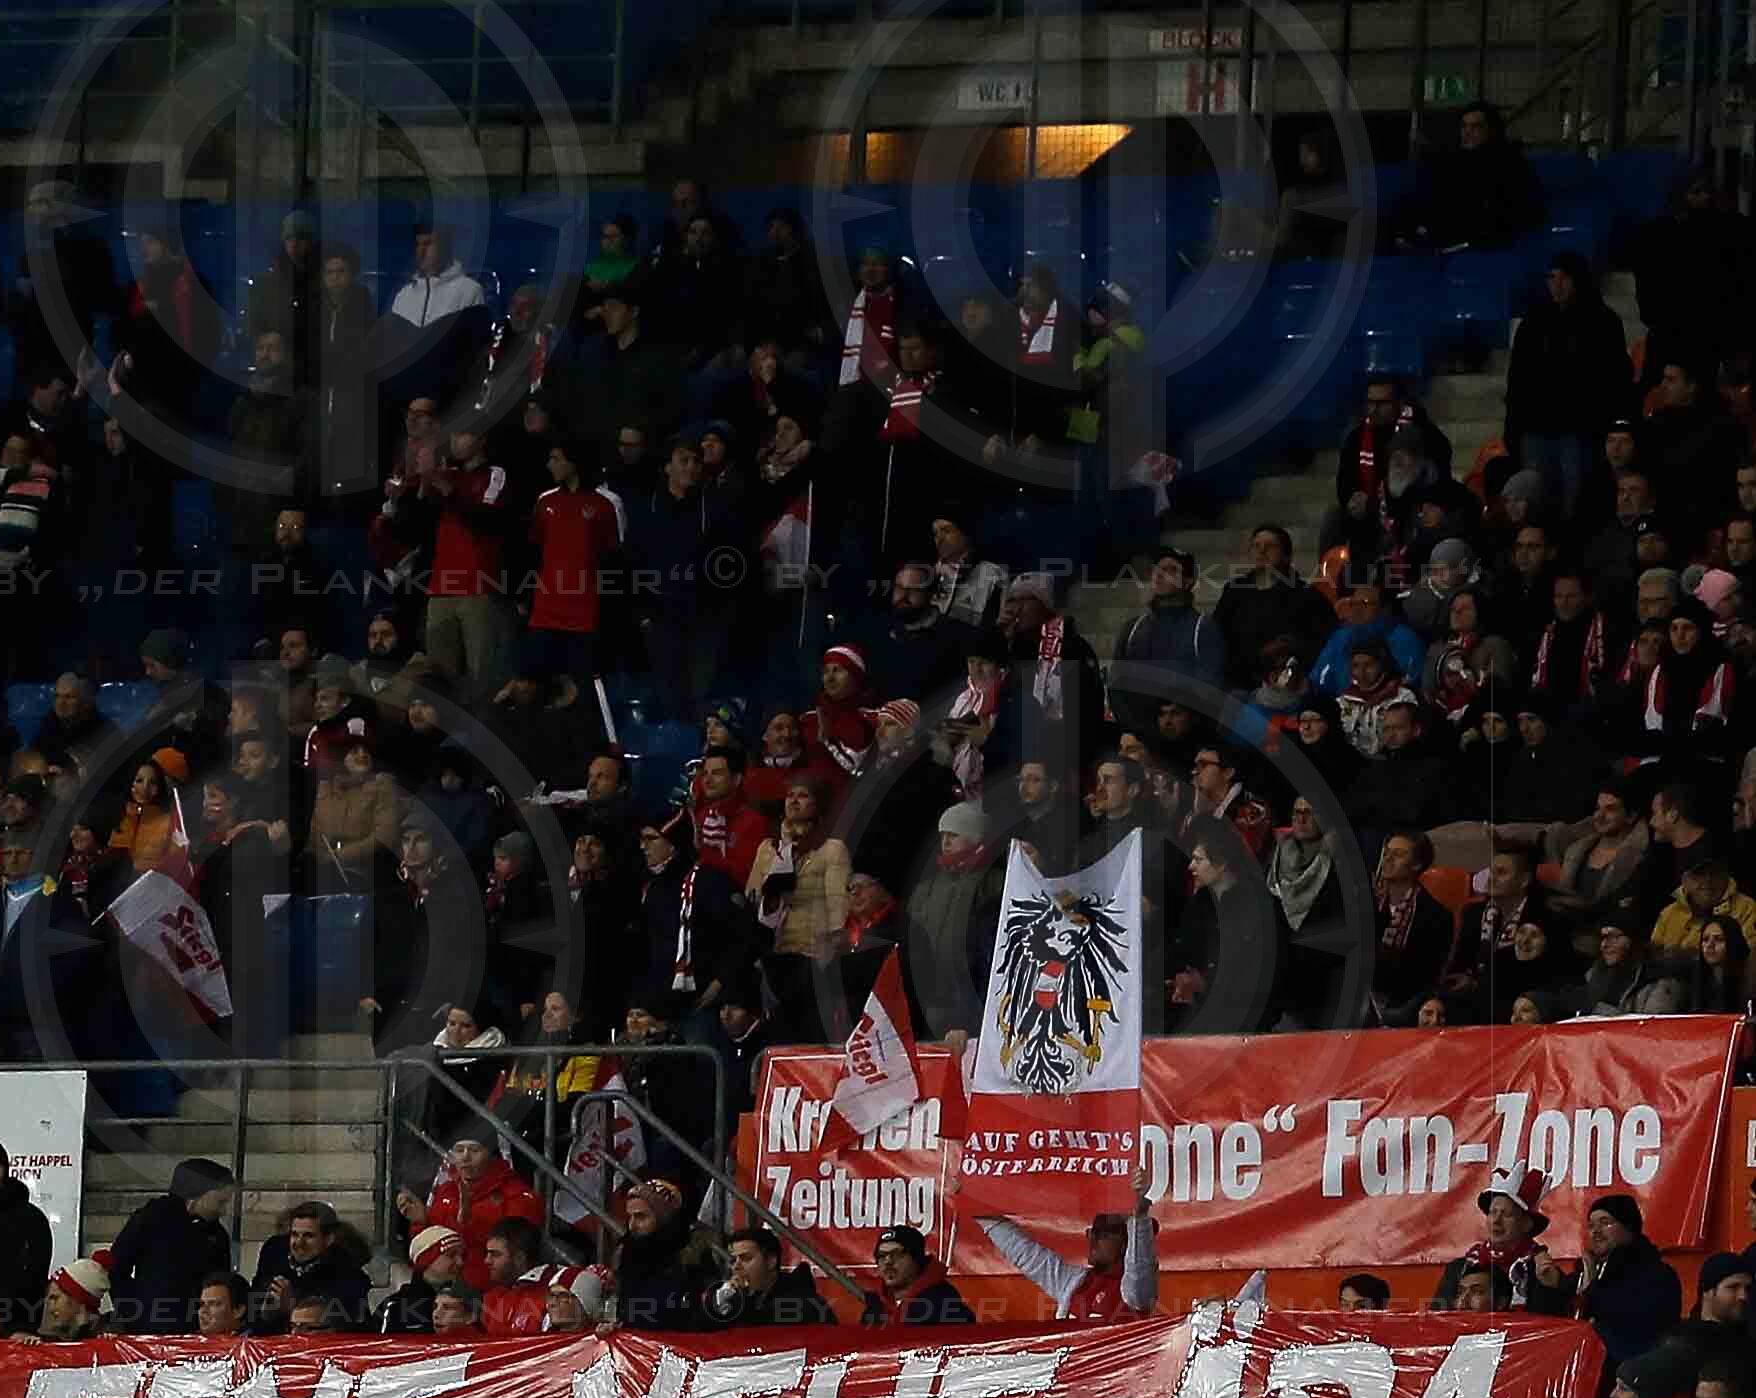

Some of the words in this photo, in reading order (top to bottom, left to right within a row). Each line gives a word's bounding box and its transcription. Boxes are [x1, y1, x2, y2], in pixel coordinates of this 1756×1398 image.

[961, 1153, 1129, 1176] ÖSTERREICH
[965, 1130, 1020, 1153] AUF
[1028, 1128, 1133, 1153] GEHT'S
[1322, 1091, 1662, 1198] Fan-Zone
[766, 1160, 936, 1236] Zeitung
